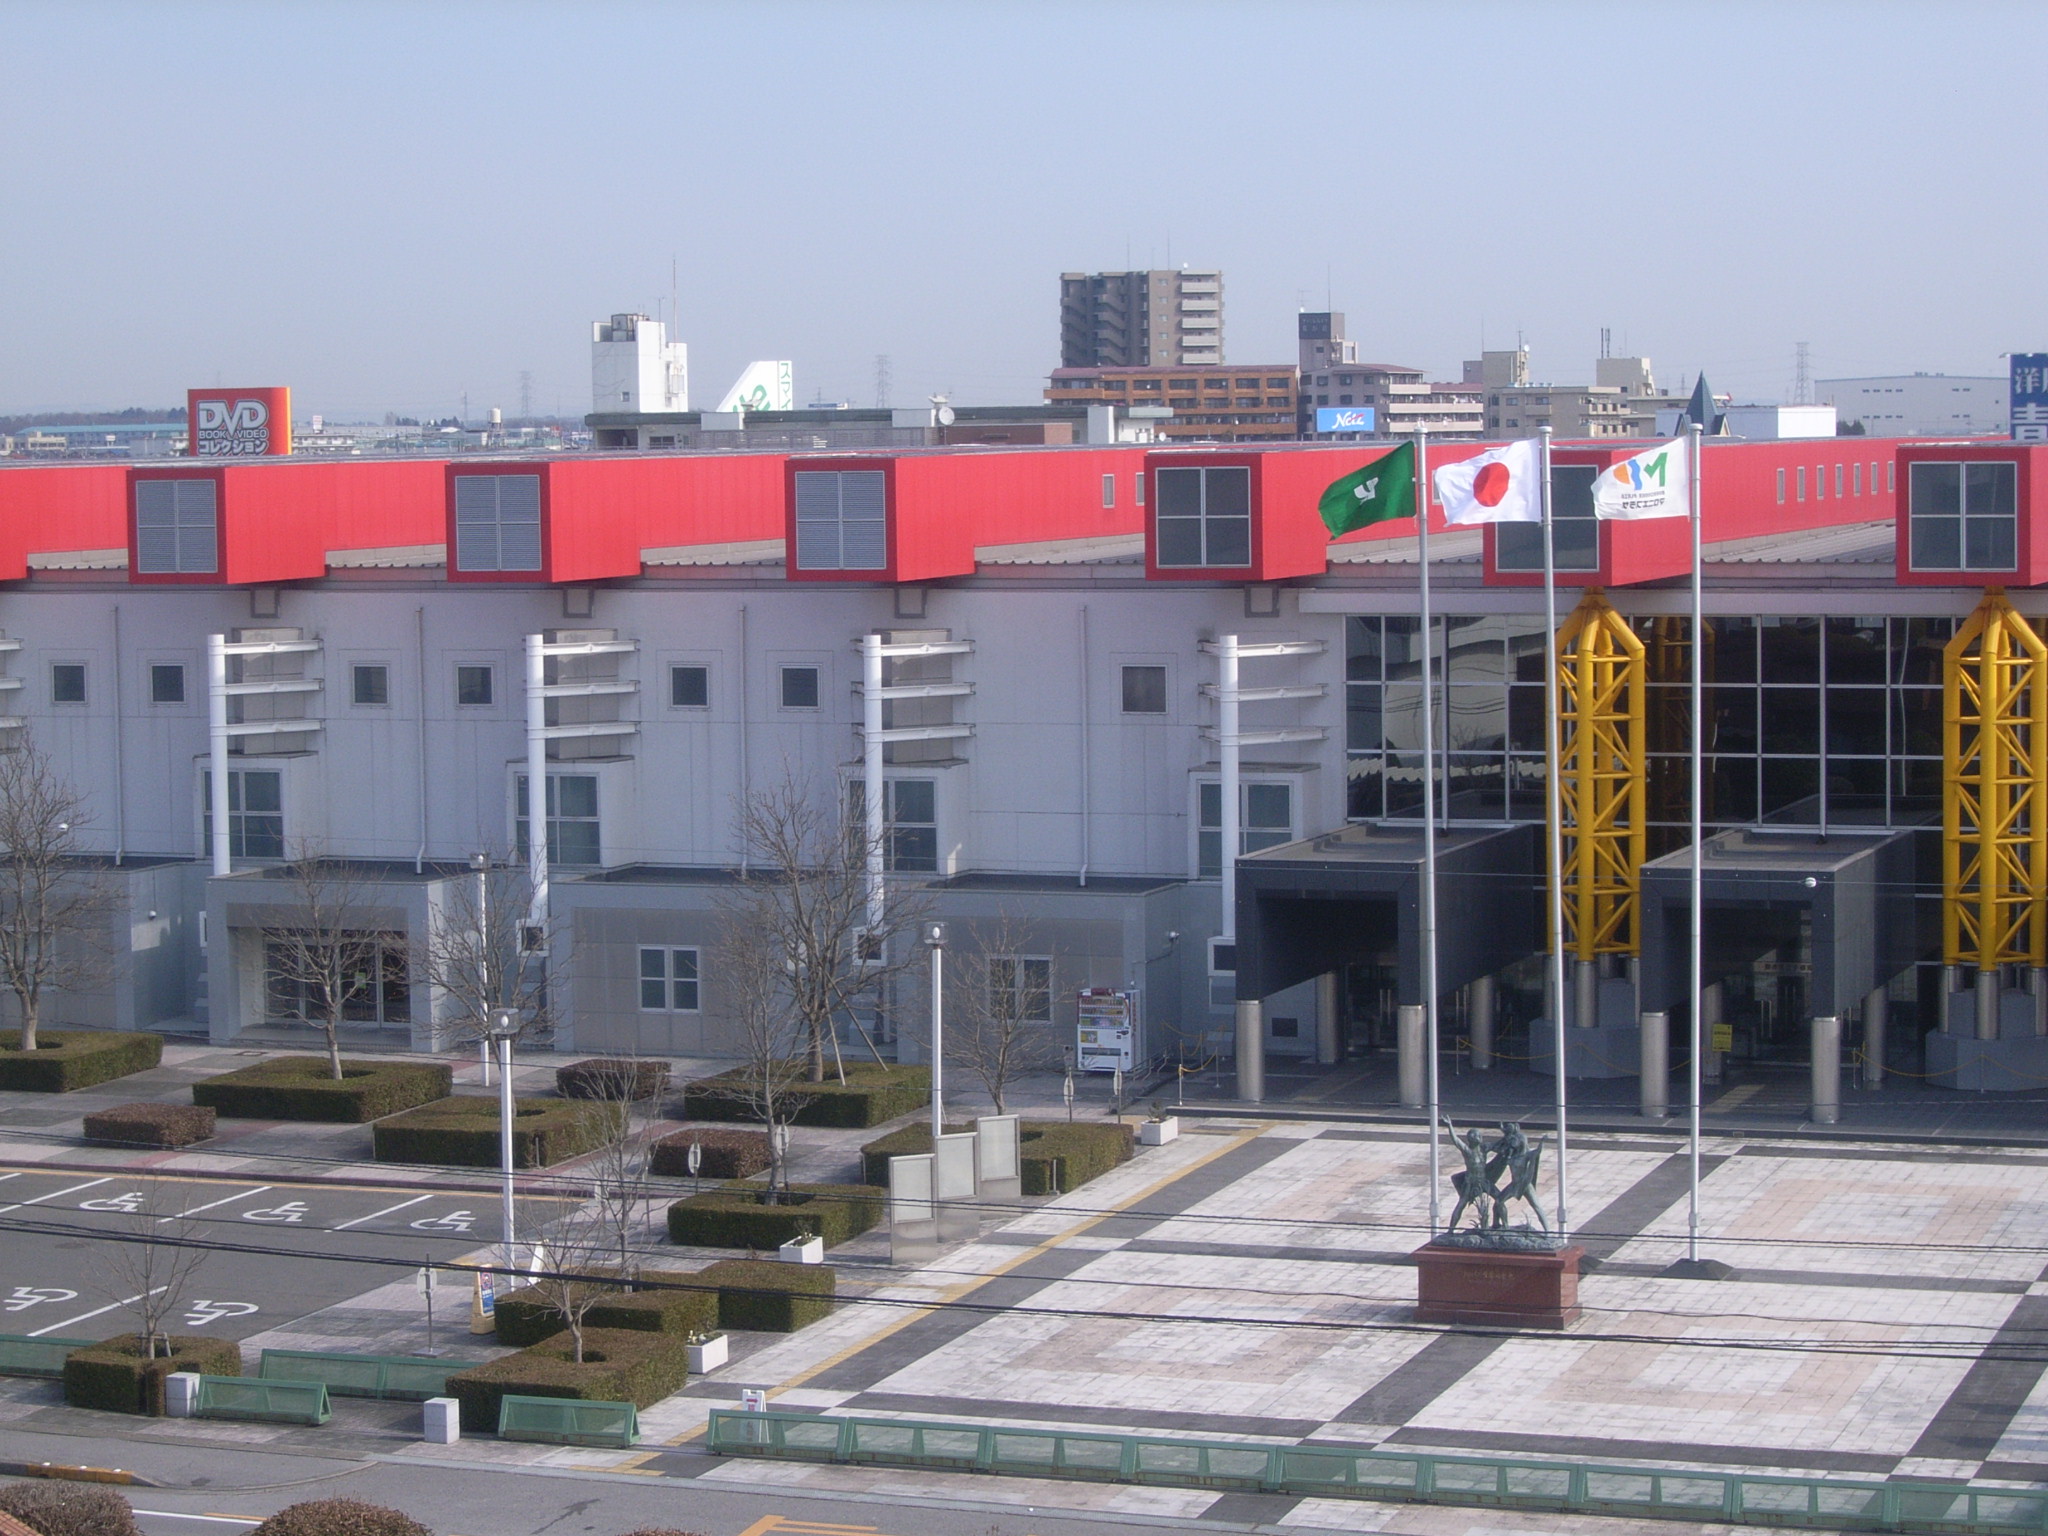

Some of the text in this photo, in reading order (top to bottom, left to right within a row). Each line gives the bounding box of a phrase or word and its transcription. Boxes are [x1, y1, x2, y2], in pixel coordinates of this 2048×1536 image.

[2015, 367, 2048, 394] 洋
[198, 401, 267, 438] DVD
[2011, 402, 2048, 440] 青
[199, 429, 267, 439] BOOK VIDEO
[199, 440, 267, 455] コレクション
